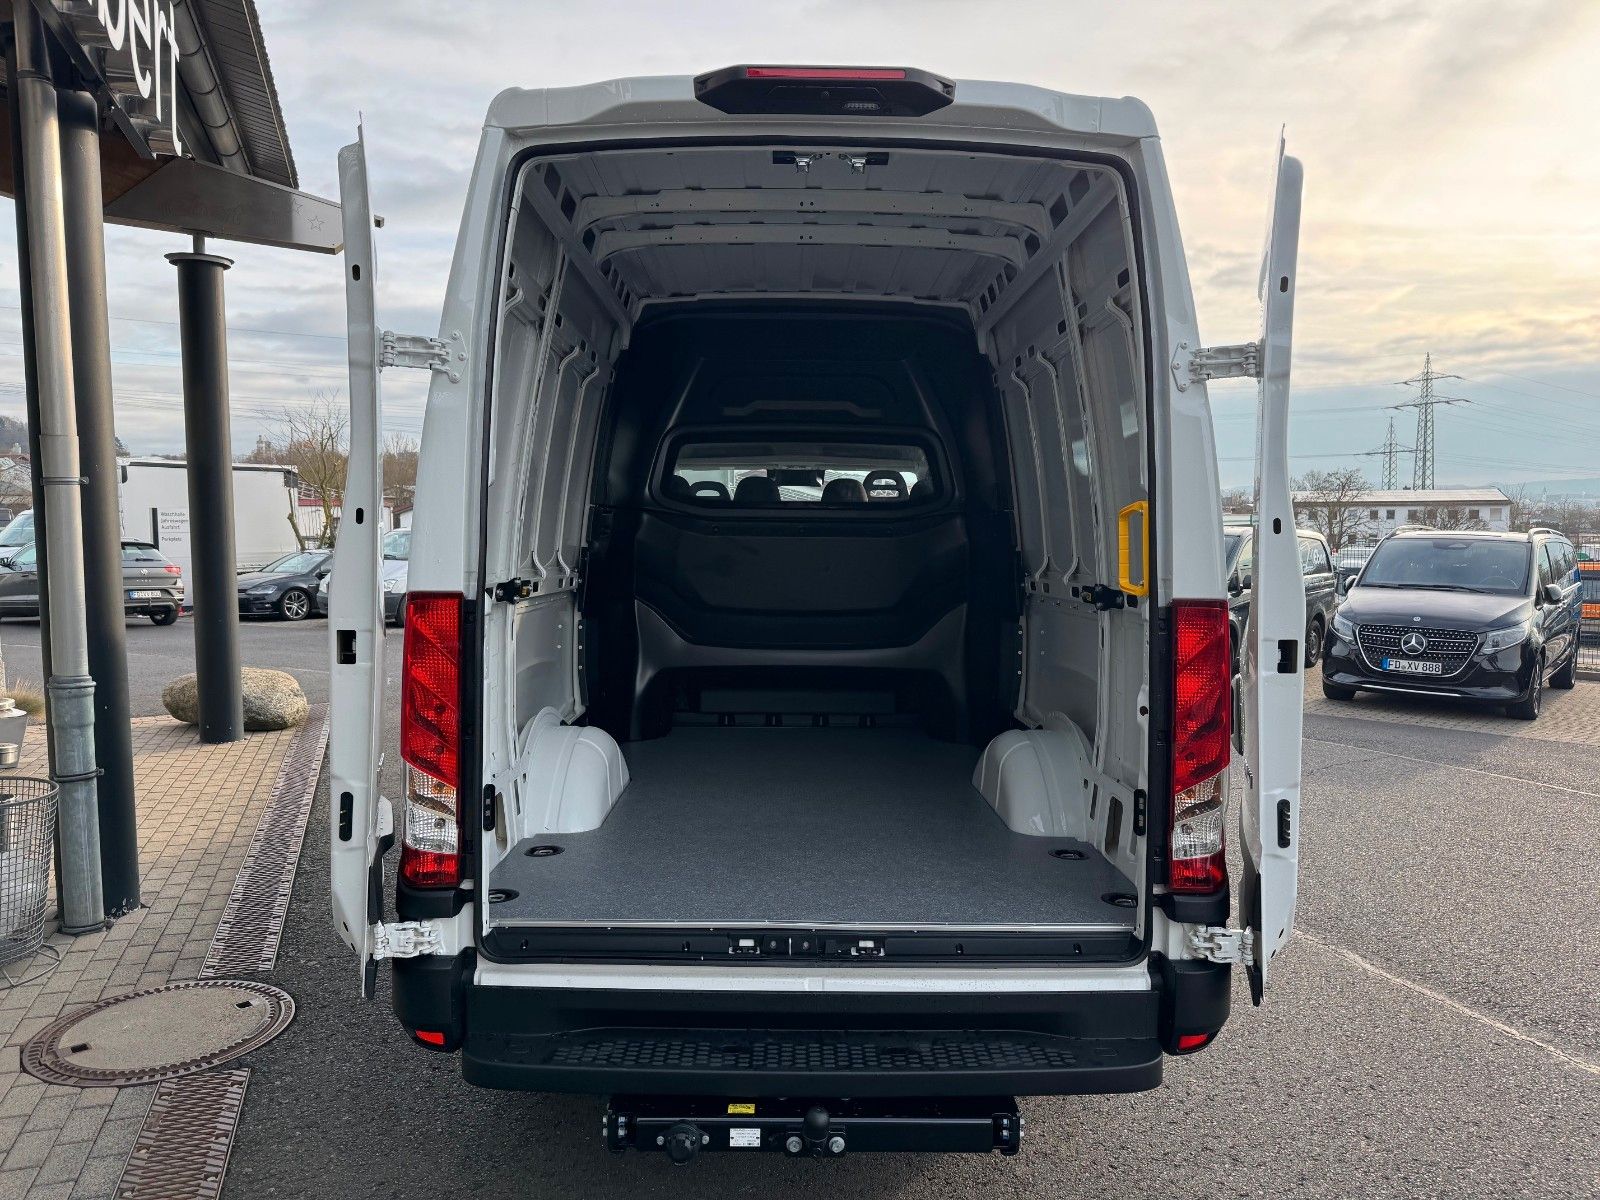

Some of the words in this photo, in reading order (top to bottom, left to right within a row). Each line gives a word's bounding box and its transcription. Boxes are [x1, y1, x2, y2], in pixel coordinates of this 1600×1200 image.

[1388, 660, 1400, 669] FD
[1407, 661, 1420, 670] XV
[1422, 663, 1441, 672] 888
